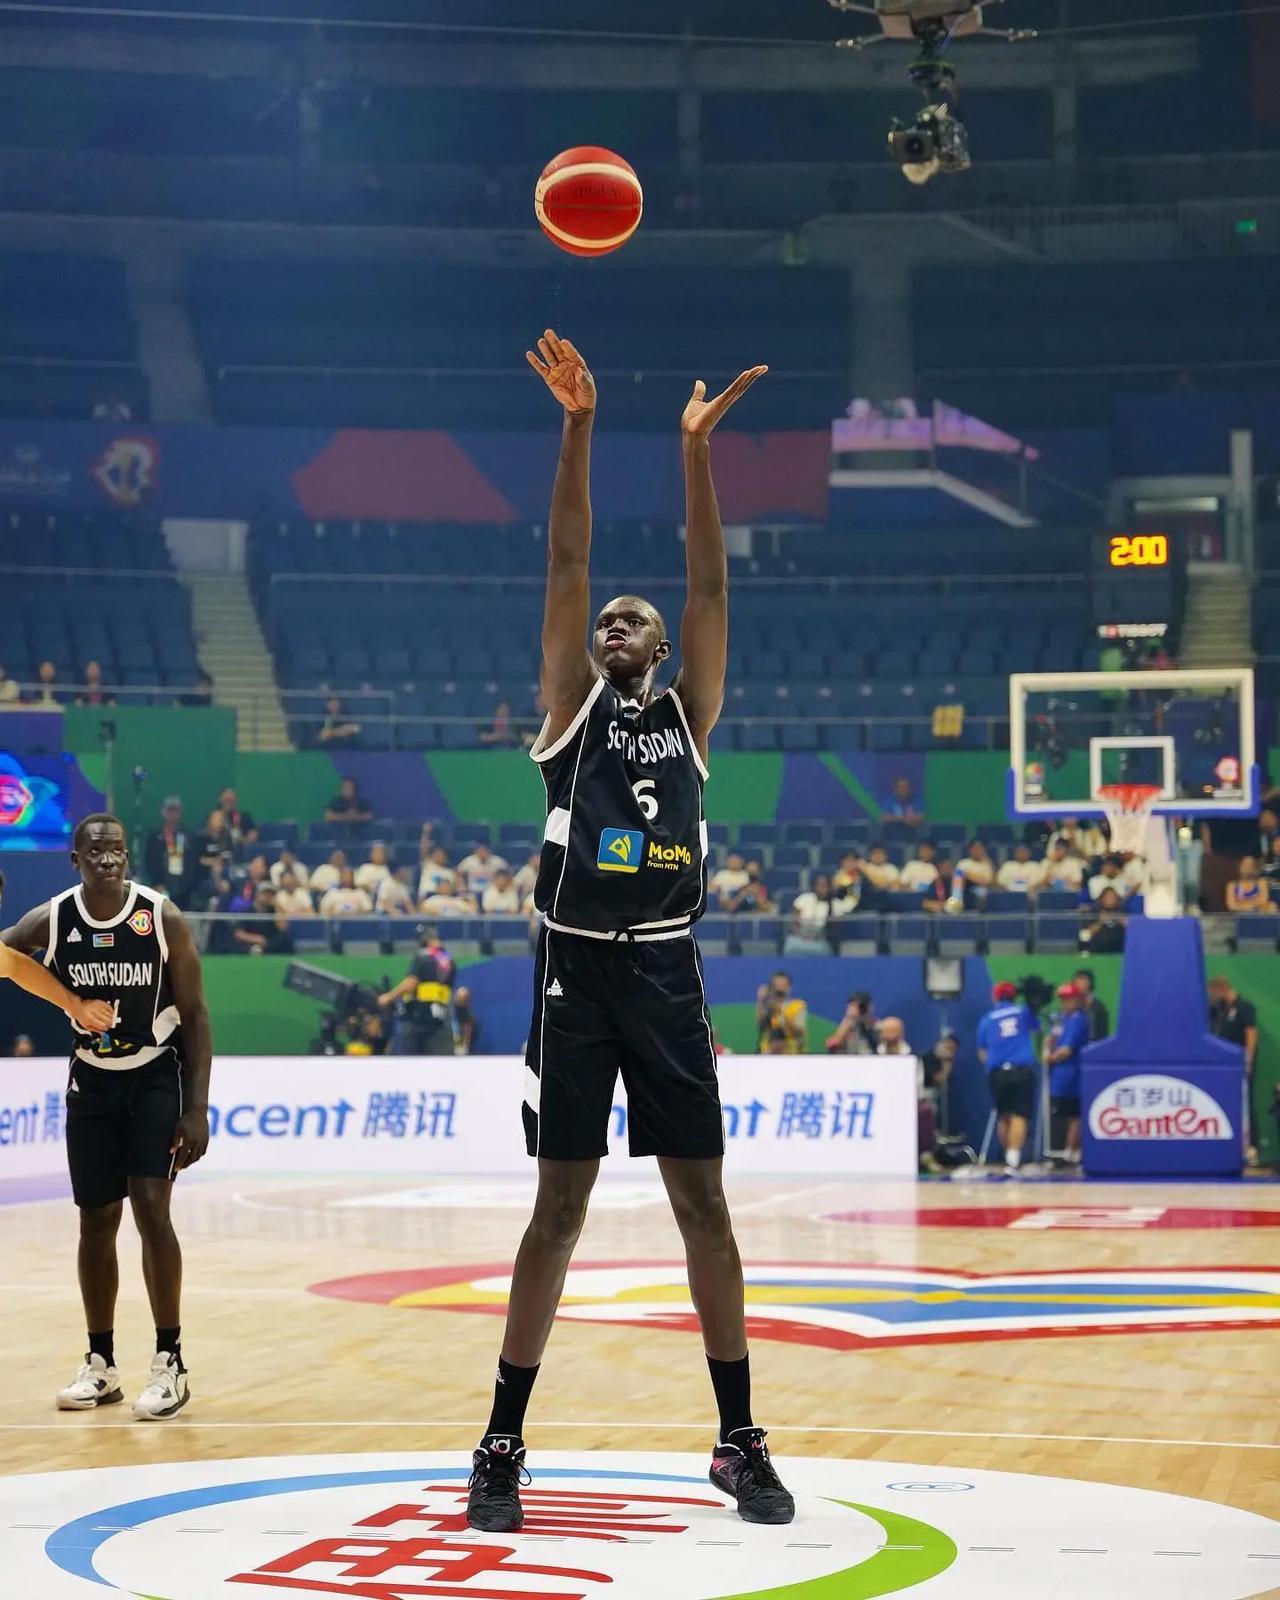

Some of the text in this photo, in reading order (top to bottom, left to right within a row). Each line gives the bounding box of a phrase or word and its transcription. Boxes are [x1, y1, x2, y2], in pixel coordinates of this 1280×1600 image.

[632, 779, 659, 820] 6
[648, 841, 691, 865] MoMo
[68, 962, 152, 987] SOUTH SUDAN
[363, 1091, 457, 1138] 腾讯
[776, 1091, 875, 1138] 腾讯
